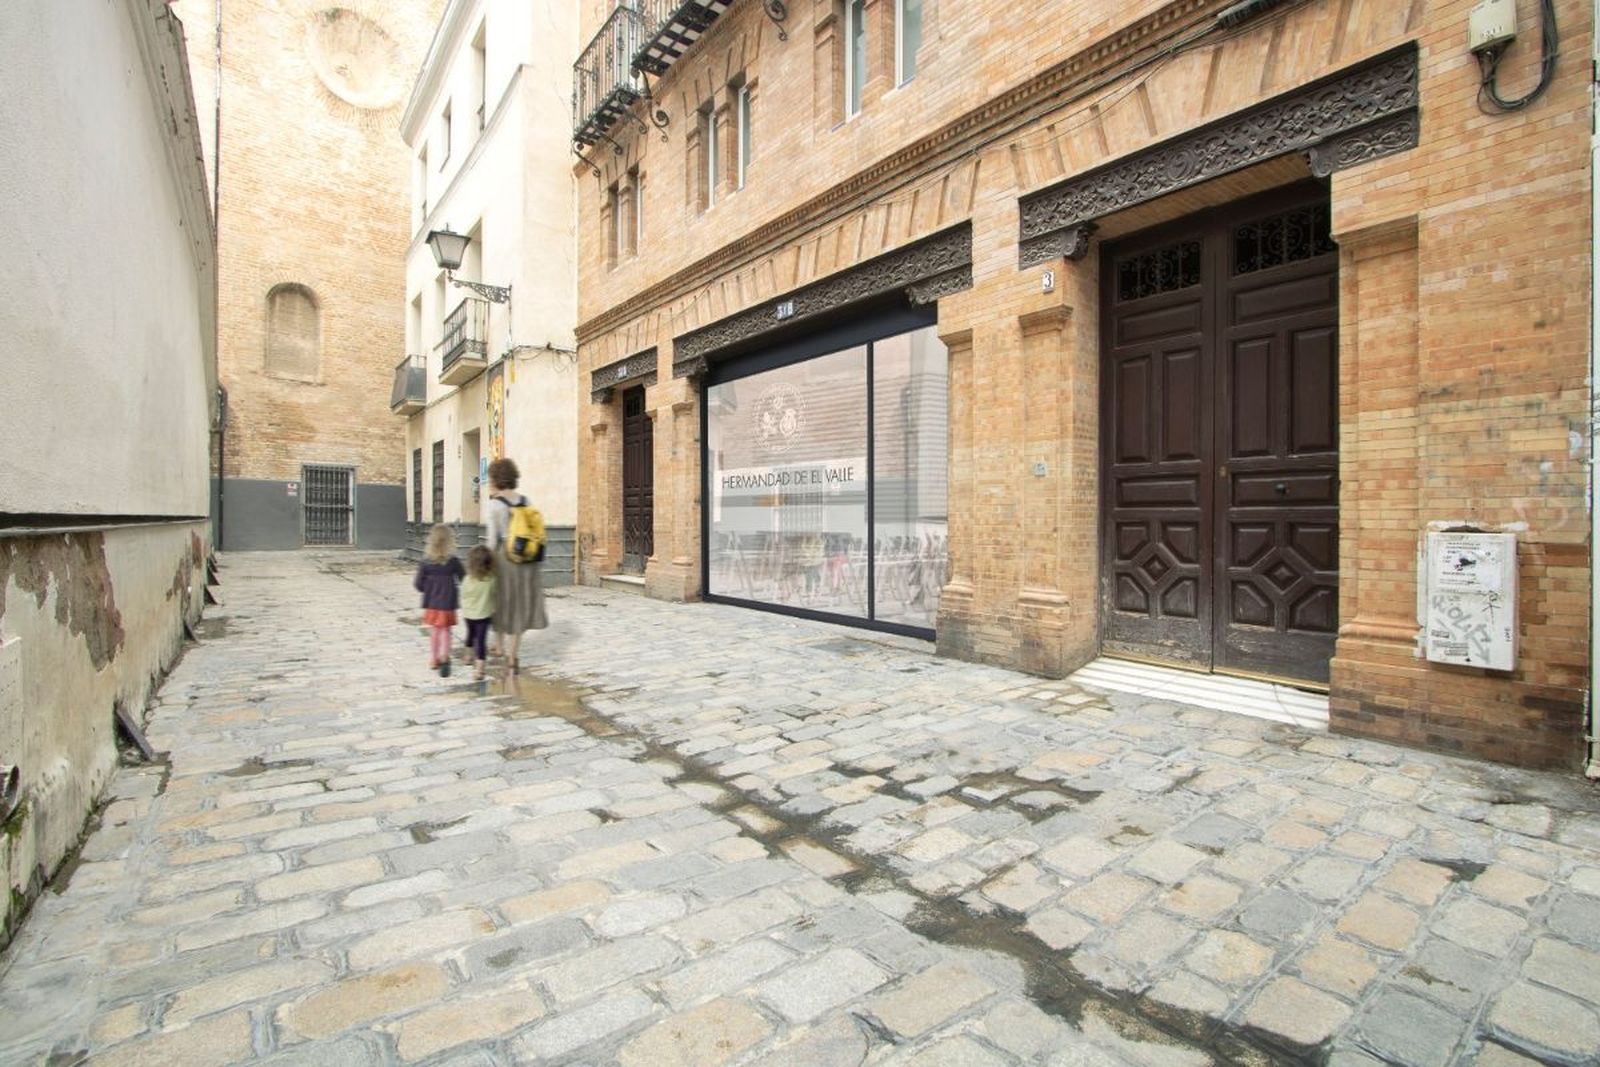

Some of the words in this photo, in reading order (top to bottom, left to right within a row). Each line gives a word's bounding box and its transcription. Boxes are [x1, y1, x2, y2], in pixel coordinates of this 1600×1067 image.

[721, 472, 790, 489] HERMANDAD
[794, 470, 808, 485] DE
[811, 469, 823, 484] EL
[825, 467, 854, 483] VALLE
